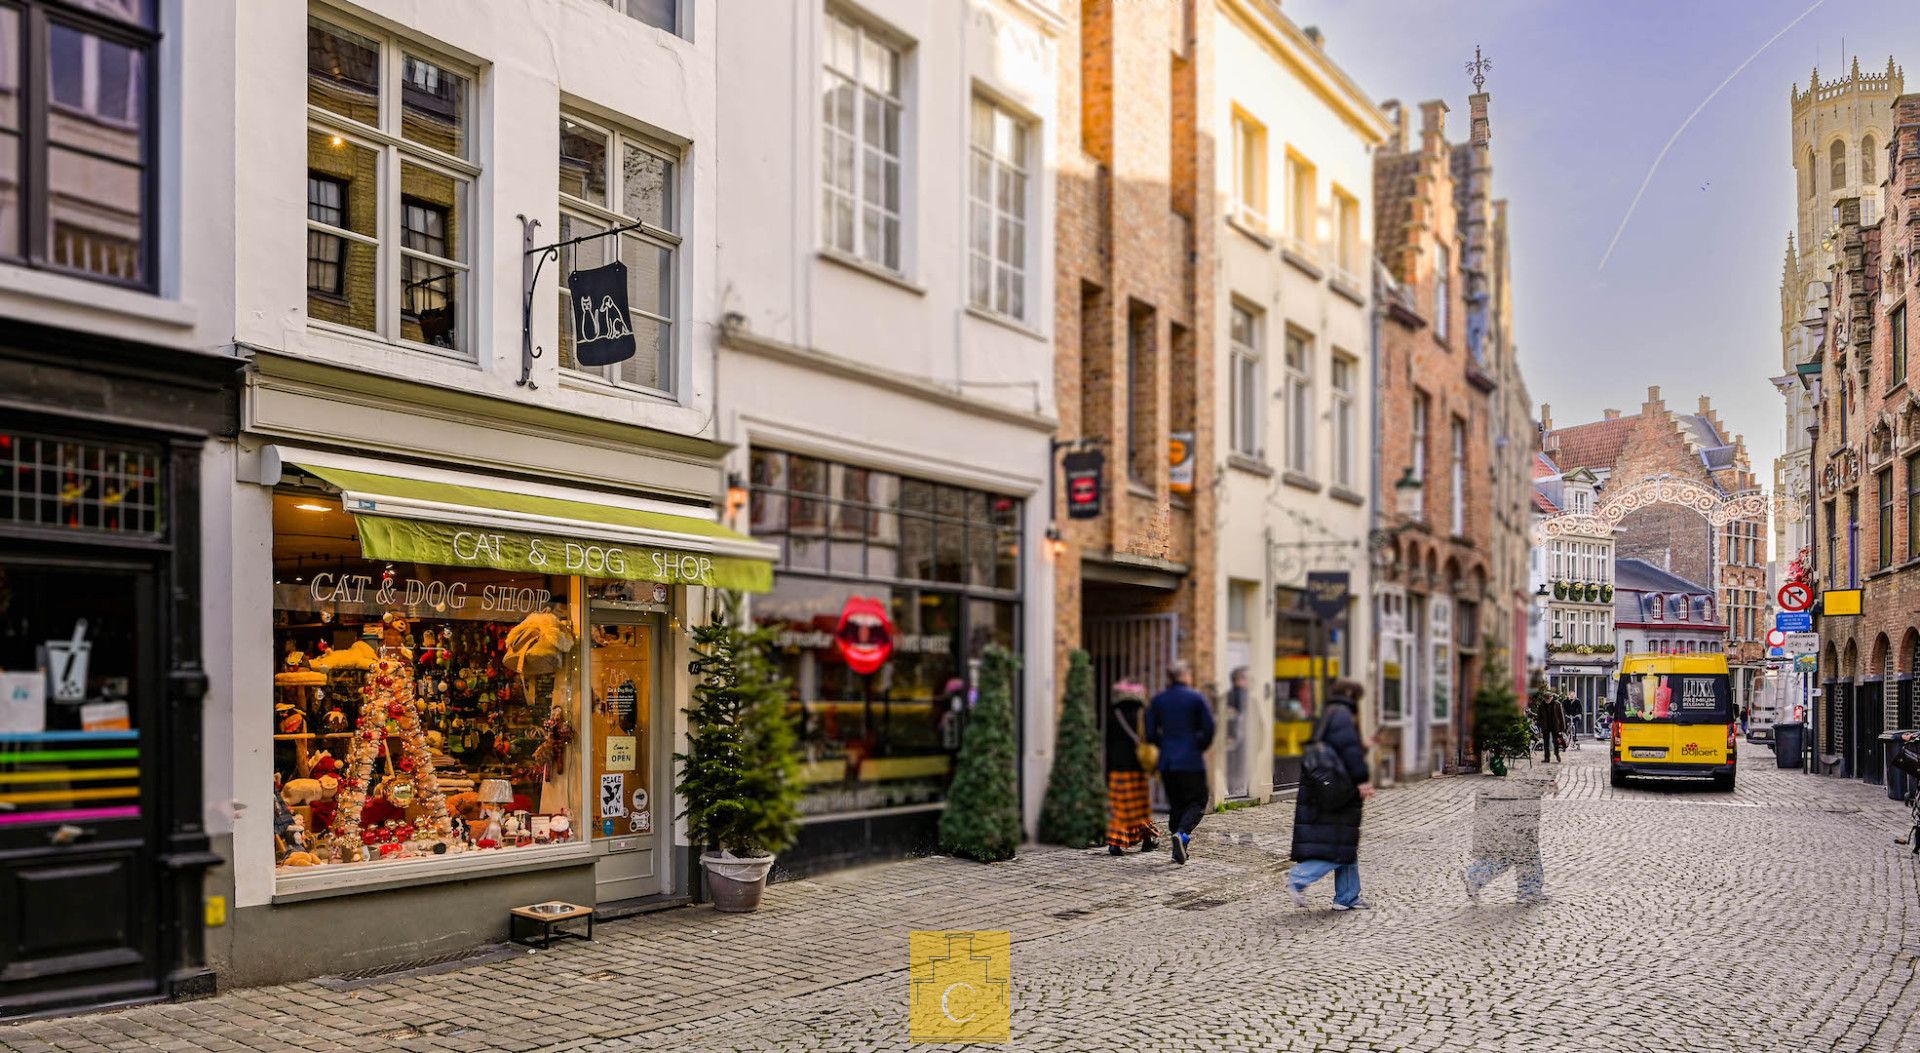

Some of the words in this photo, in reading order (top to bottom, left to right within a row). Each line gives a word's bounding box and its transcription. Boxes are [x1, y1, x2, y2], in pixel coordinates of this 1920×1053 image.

[453, 532, 504, 561] CAT
[528, 538, 548, 566] &
[566, 543, 625, 574] DOG
[651, 552, 712, 580] SHOP
[310, 572, 372, 603] CAT
[375, 577, 397, 605] &
[403, 578, 468, 610] DOG
[480, 584, 551, 613] SHOP
[1682, 680, 1716, 698] LUXX
[611, 754, 632, 762] OPEN
[602, 775, 622, 784] PEACE
[602, 805, 621, 815] NOW
